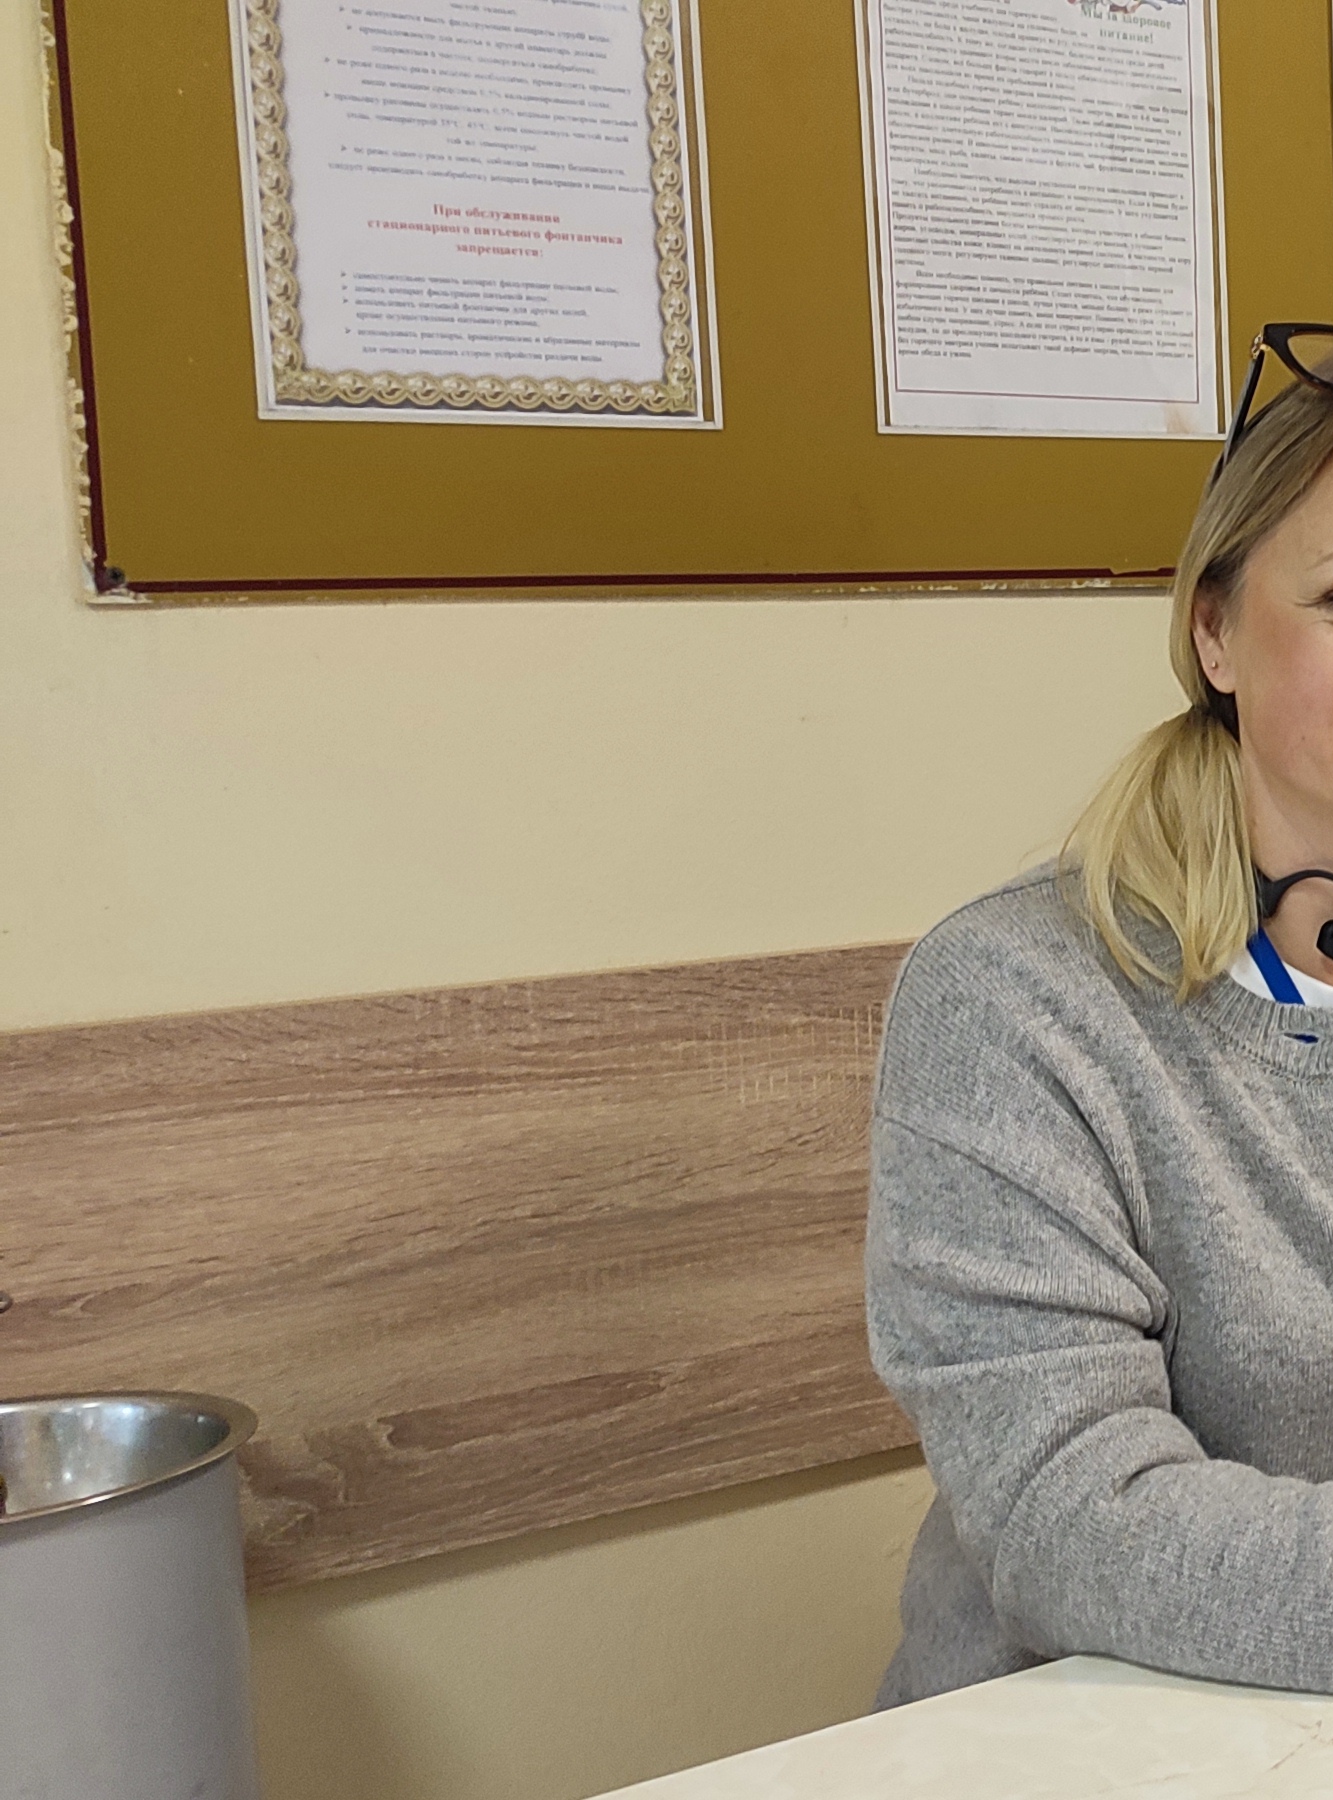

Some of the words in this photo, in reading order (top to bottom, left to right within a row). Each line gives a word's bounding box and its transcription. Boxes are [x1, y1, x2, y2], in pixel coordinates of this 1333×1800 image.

[433, 203, 461, 218] При
[465, 207, 561, 224] обслуживании
[367, 219, 470, 234] стационарного
[474, 226, 541, 239] питьевого
[544, 229, 623, 245] фонтанчика
